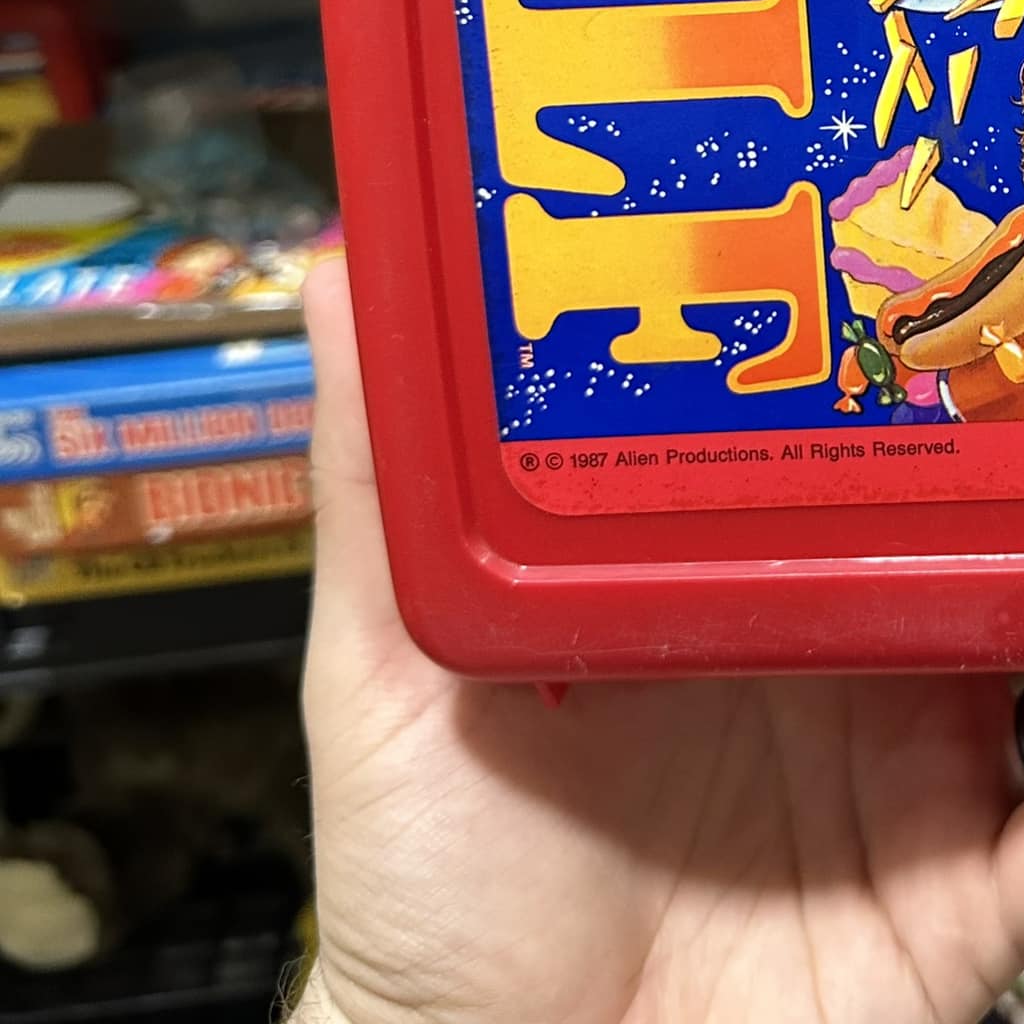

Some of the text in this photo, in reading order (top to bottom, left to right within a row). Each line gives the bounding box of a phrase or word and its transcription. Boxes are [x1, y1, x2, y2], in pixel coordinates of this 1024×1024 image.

[570, 452, 609, 468] 1987
[615, 450, 659, 466] Alien
[666, 446, 774, 464] Productions.
[781, 444, 803, 460] All
[811, 442, 865, 462] Rights
[873, 439, 960, 456] Reserved.
